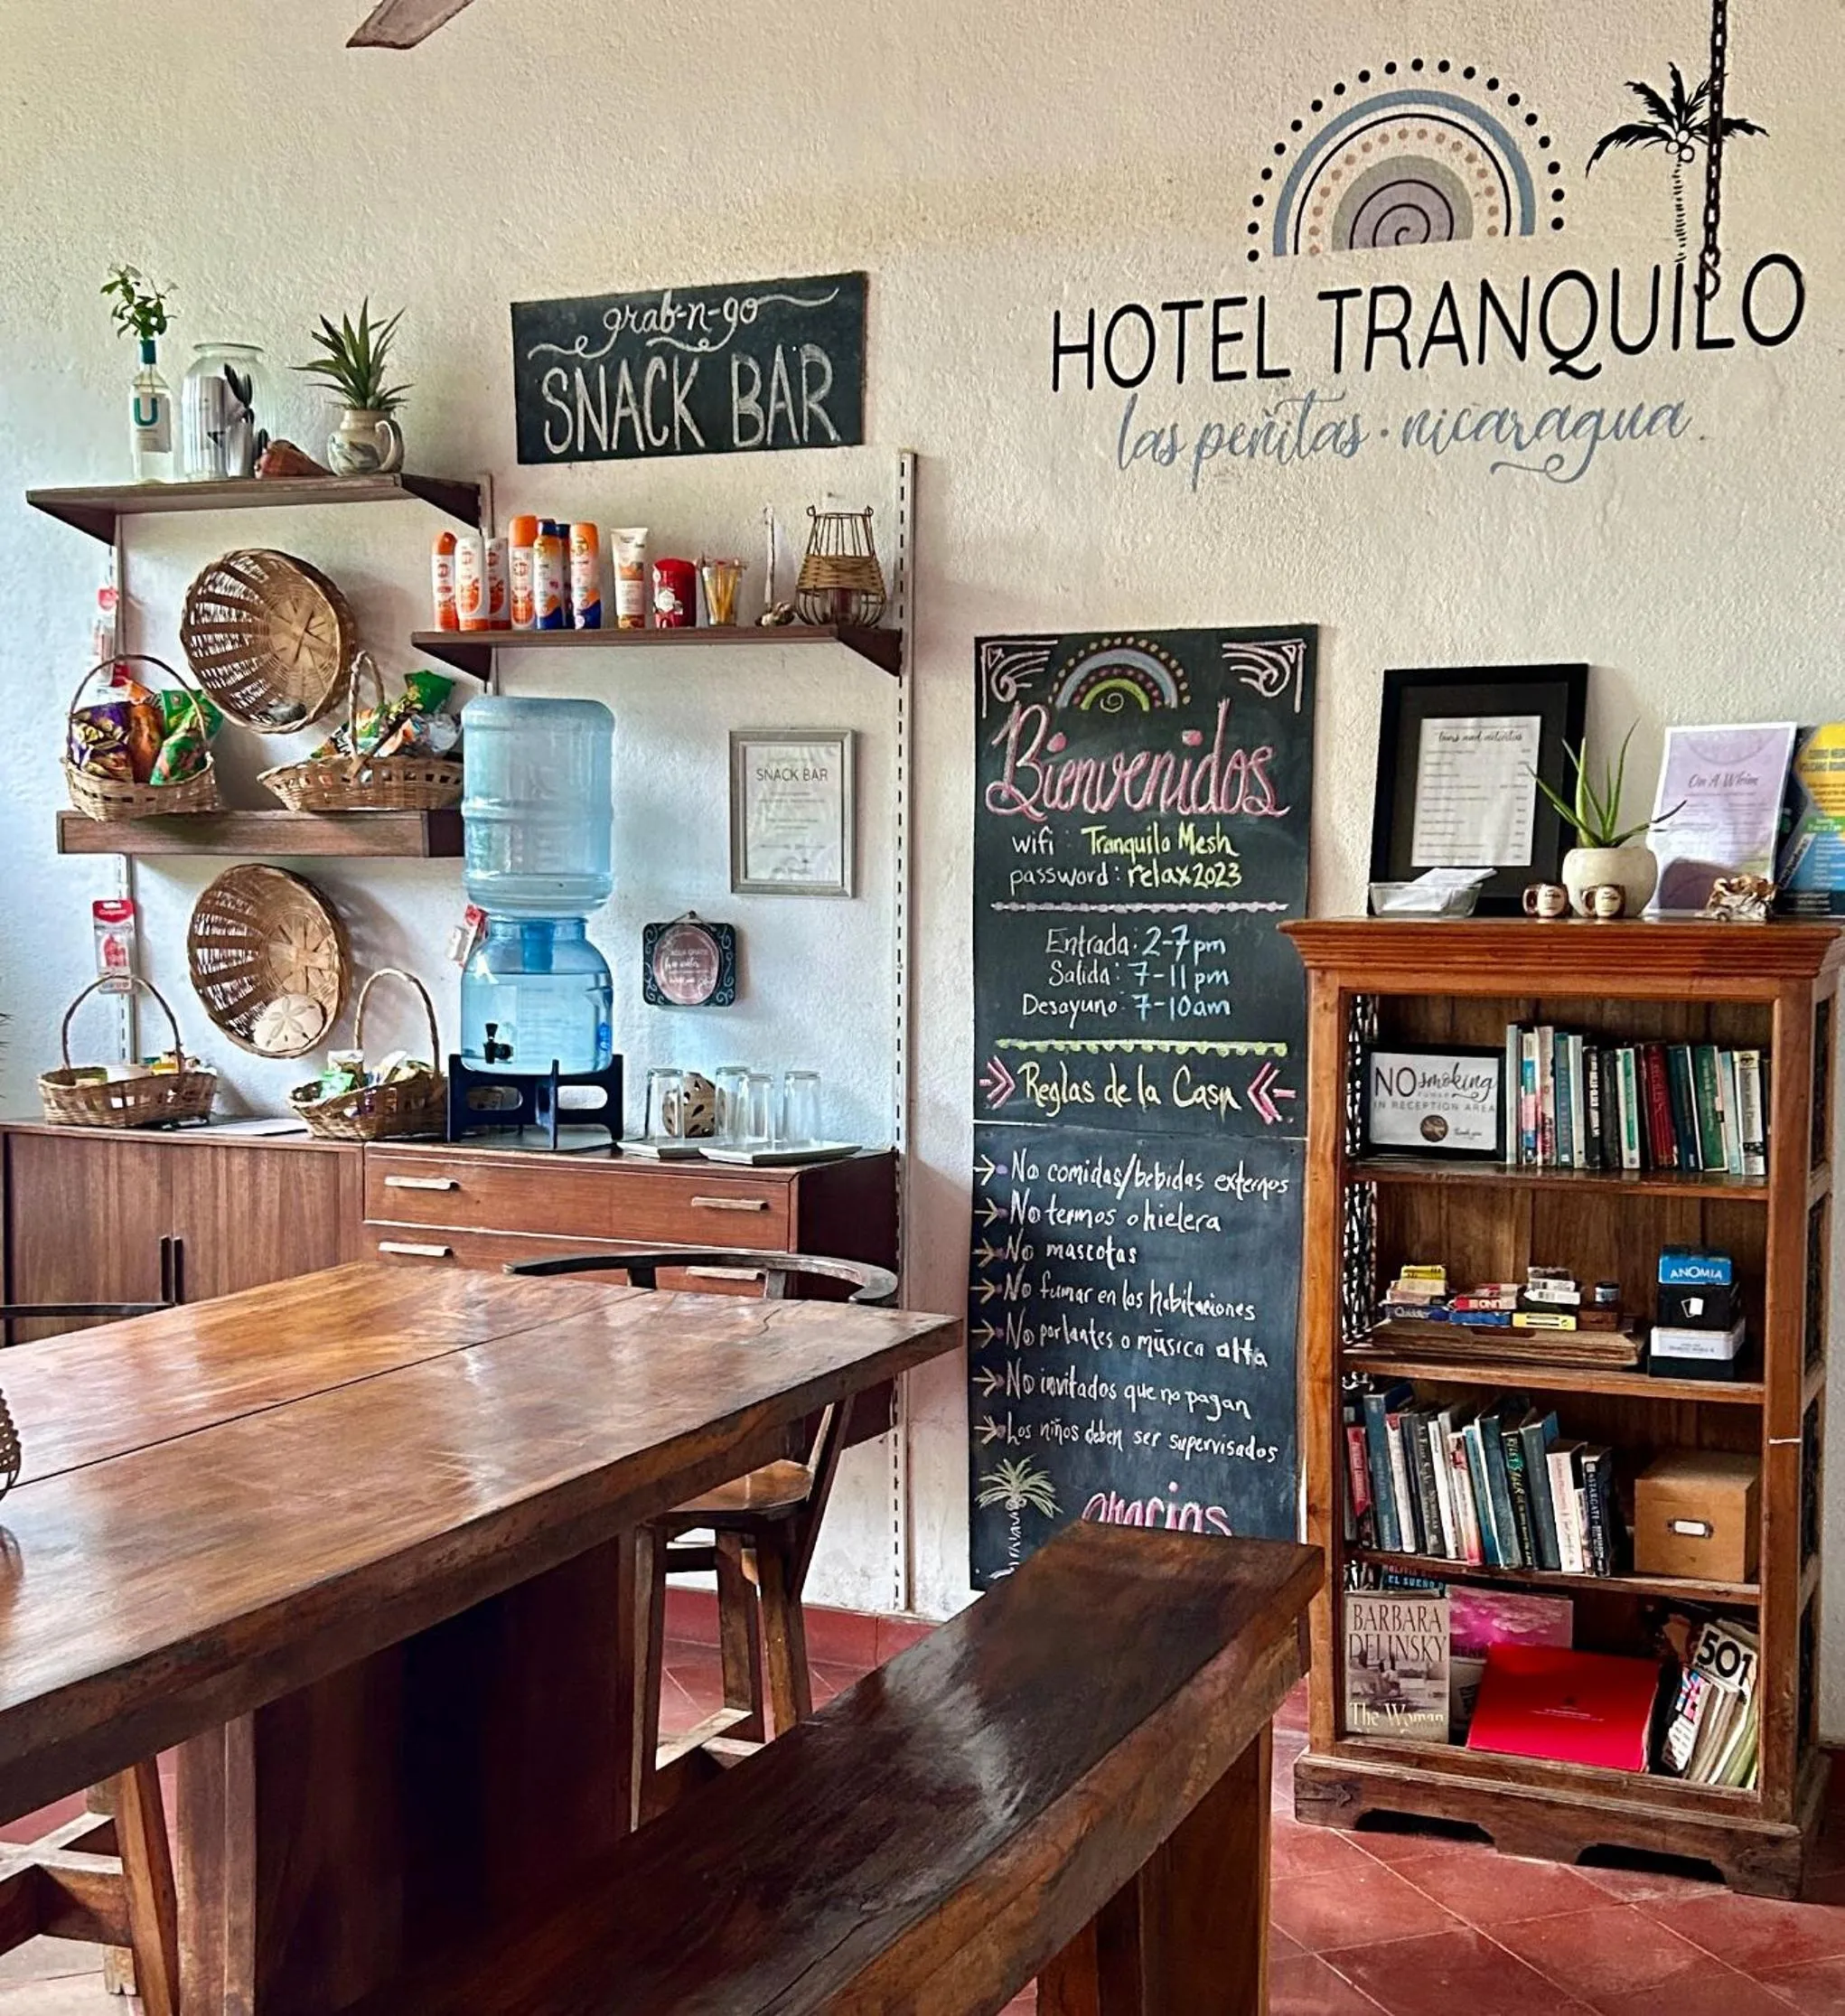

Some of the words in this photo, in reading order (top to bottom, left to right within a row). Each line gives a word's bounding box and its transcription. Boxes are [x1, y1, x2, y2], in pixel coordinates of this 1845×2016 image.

[1052, 295, 1291, 392] HOTEL
[1316, 253, 1806, 380] TRANQUILO
[542, 356, 706, 454] SNACK
[732, 343, 842, 447] BAR
[1118, 392, 1188, 471] las
[1401, 400, 1693, 483] nicaragua
[755, 768, 799, 782] SNACK
[803, 768, 829, 782] BAR
[985, 696, 1291, 821] Bienvenidos
[1689, 774, 1706, 788] On
[1081, 822, 1171, 863] Tranquilo
[1178, 821, 1240, 857] Mesh
[1128, 862, 1242, 888] relax2023
[1017, 1060, 1096, 1119] Reglas
[1103, 1064, 1131, 1109] de
[1138, 1063, 1161, 1107] la
[1375, 1066, 1417, 1097] NO
[1418, 1062, 1496, 1102] smoking
[1391, 1101, 1458, 1111] RECEPTION
[1465, 1102, 1496, 1113] AREA
[1011, 1148, 1040, 1183] No
[1047, 1153, 1204, 1200] comidas/bebidas
[1009, 1188, 1040, 1224] No
[1044, 1193, 1115, 1229] termos
[1127, 1213, 1138, 1225] o
[1143, 1198, 1222, 1233] hielera
[1005, 1228, 1034, 1262] No
[1046, 1234, 1138, 1270] mascotas
[1003, 1263, 1032, 1301] No
[1040, 1270, 1091, 1304] fumar
[1098, 1288, 1116, 1305] en
[1122, 1279, 1143, 1310] las
[1670, 1266, 1723, 1280] ANOMIA
[1006, 1307, 1035, 1350] No
[1121, 1335, 1130, 1350] o
[1216, 1336, 1269, 1368] alta
[1006, 1356, 1035, 1401] No
[1040, 1365, 1118, 1400] invitados
[1124, 1384, 1157, 1412] que
[1161, 1388, 1181, 1404] no
[1185, 1391, 1252, 1421] pagan
[1007, 1411, 1032, 1446] Los
[1085, 1419, 1123, 1451] deben
[1132, 1430, 1161, 1447] ser
[1169, 1431, 1280, 1463] supervisados
[1353, 1604, 1443, 1633] BARBARA
[1349, 1633, 1447, 1663] DELINSKY
[1697, 1630, 1753, 1687] 501
[1350, 1702, 1379, 1727] The
[1383, 1702, 1444, 1726] Woman
